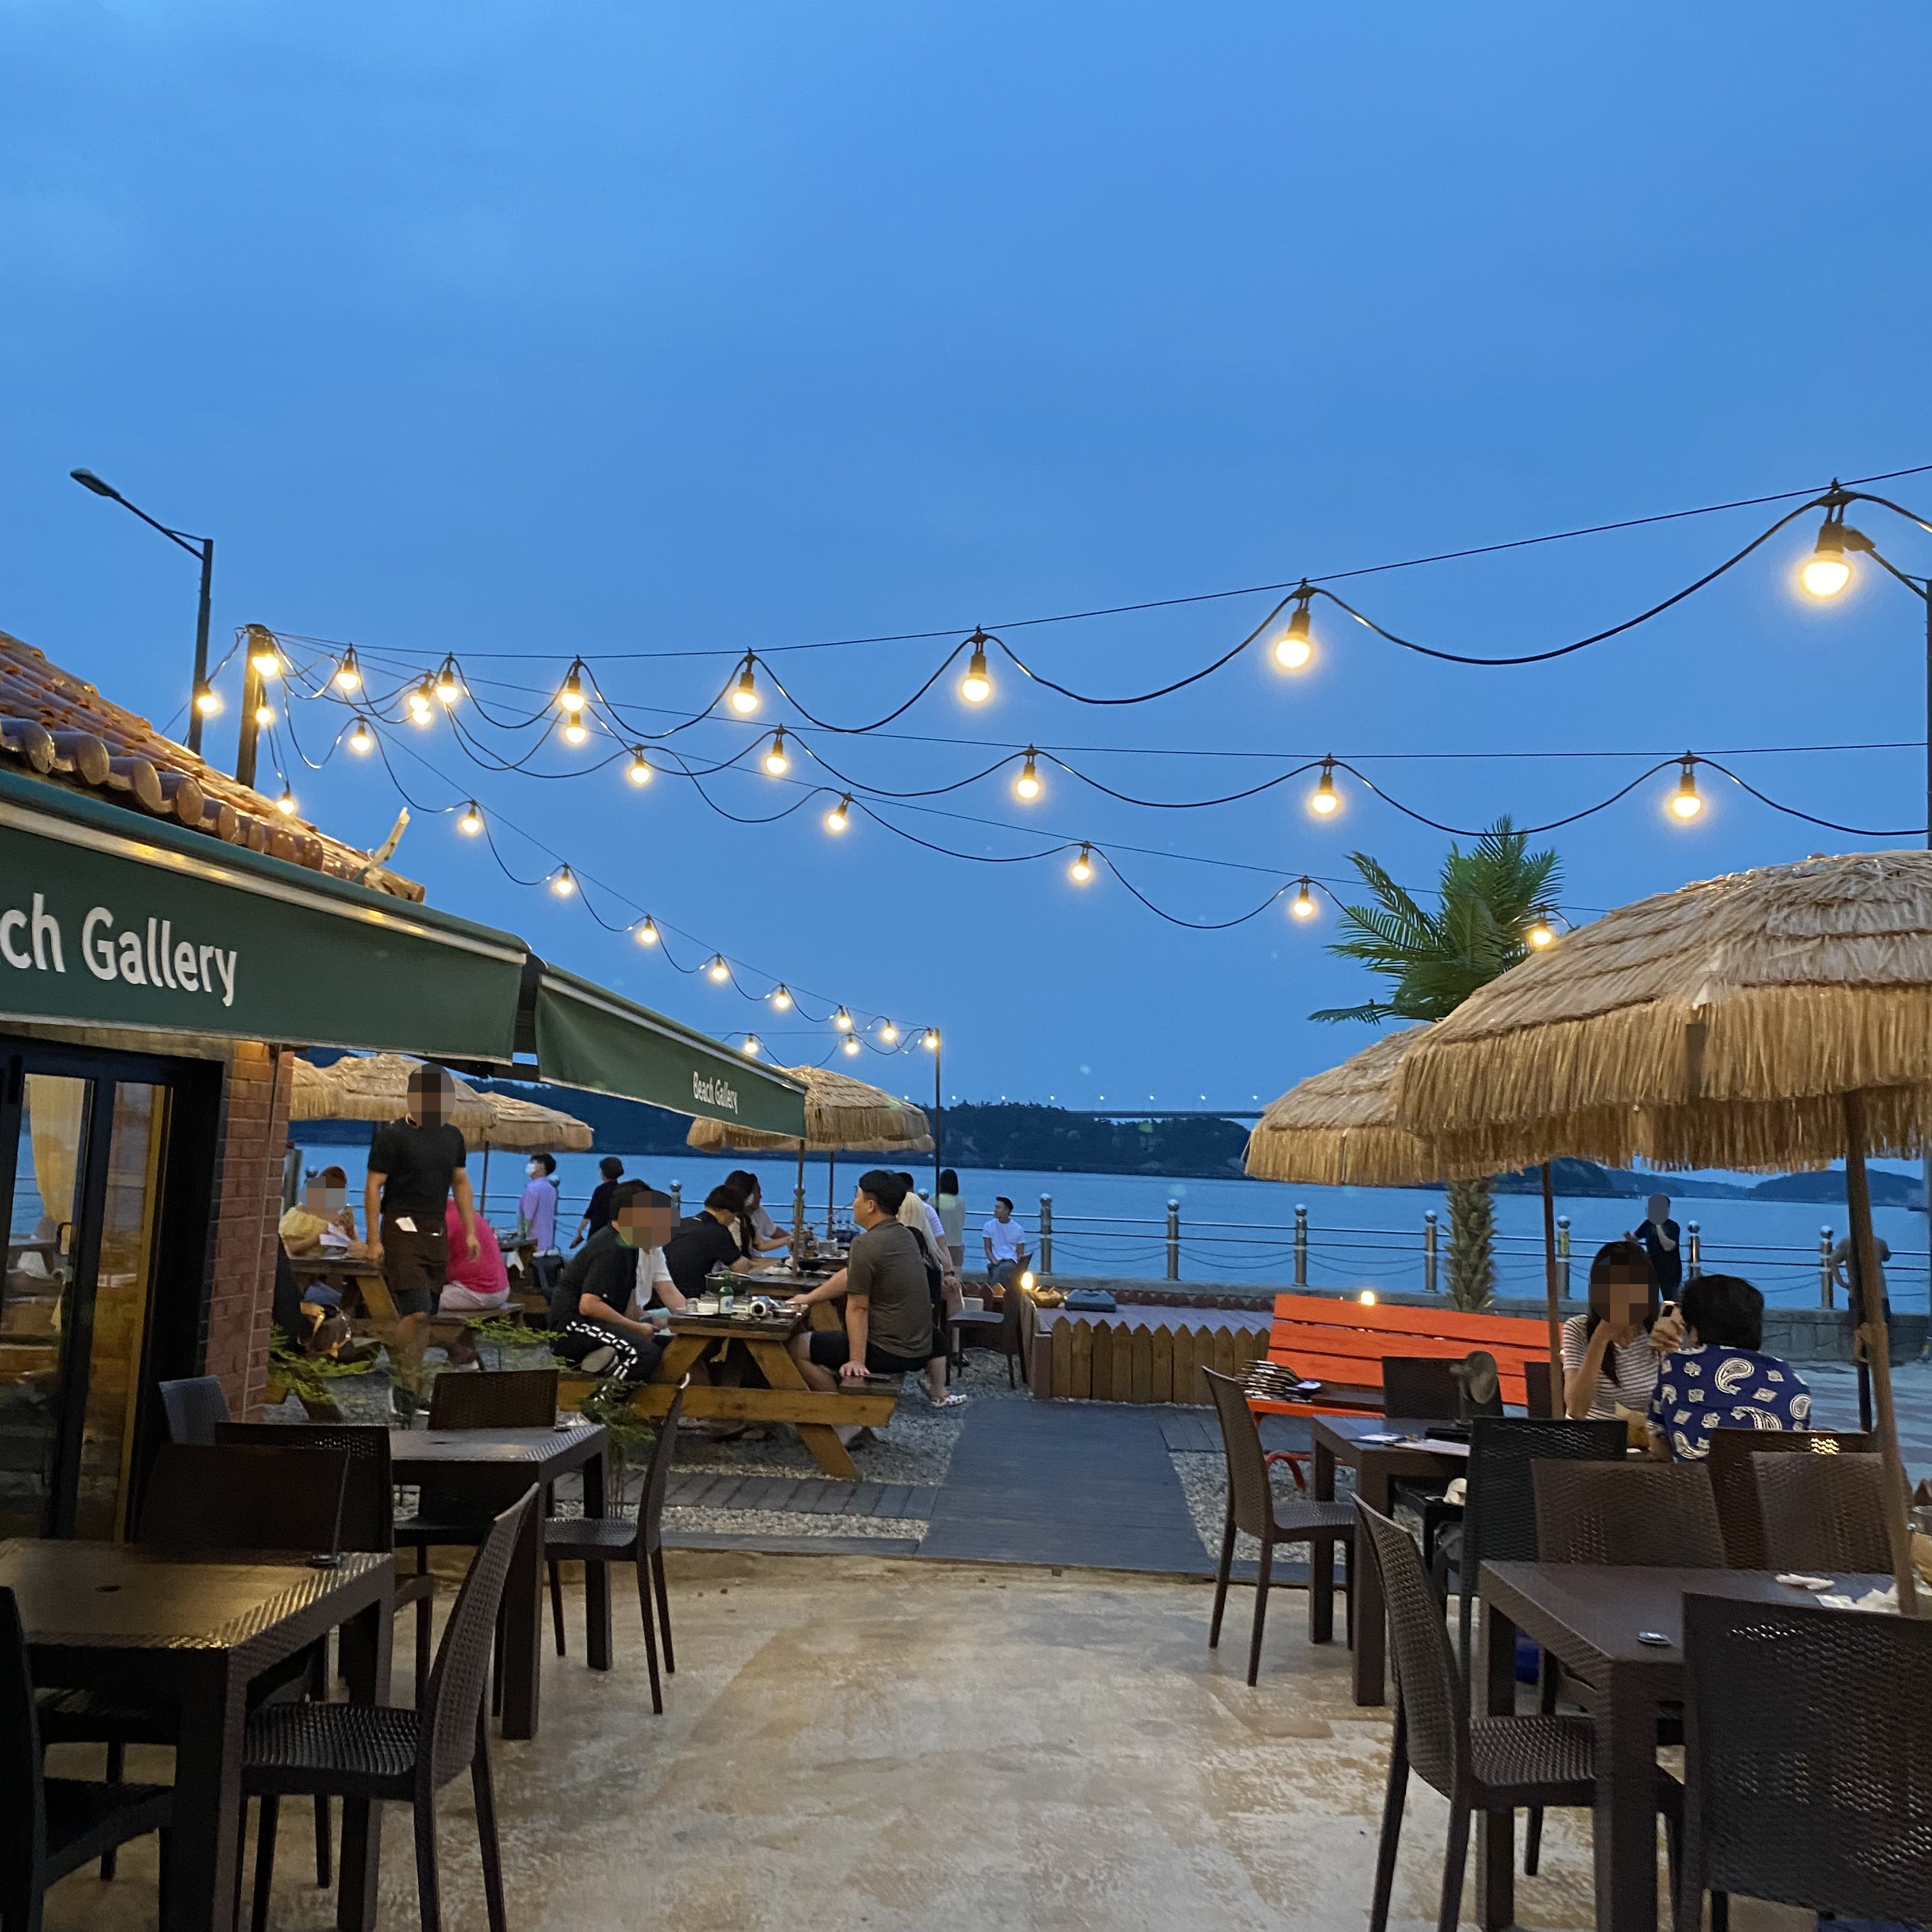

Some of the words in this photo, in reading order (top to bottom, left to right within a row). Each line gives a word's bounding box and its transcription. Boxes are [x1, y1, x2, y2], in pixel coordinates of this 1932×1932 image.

[0, 892, 66, 972] ch
[82, 907, 237, 1007] Gallery
[693, 1071, 716, 1105] Beach
[715, 1079, 738, 1114] Gallery
